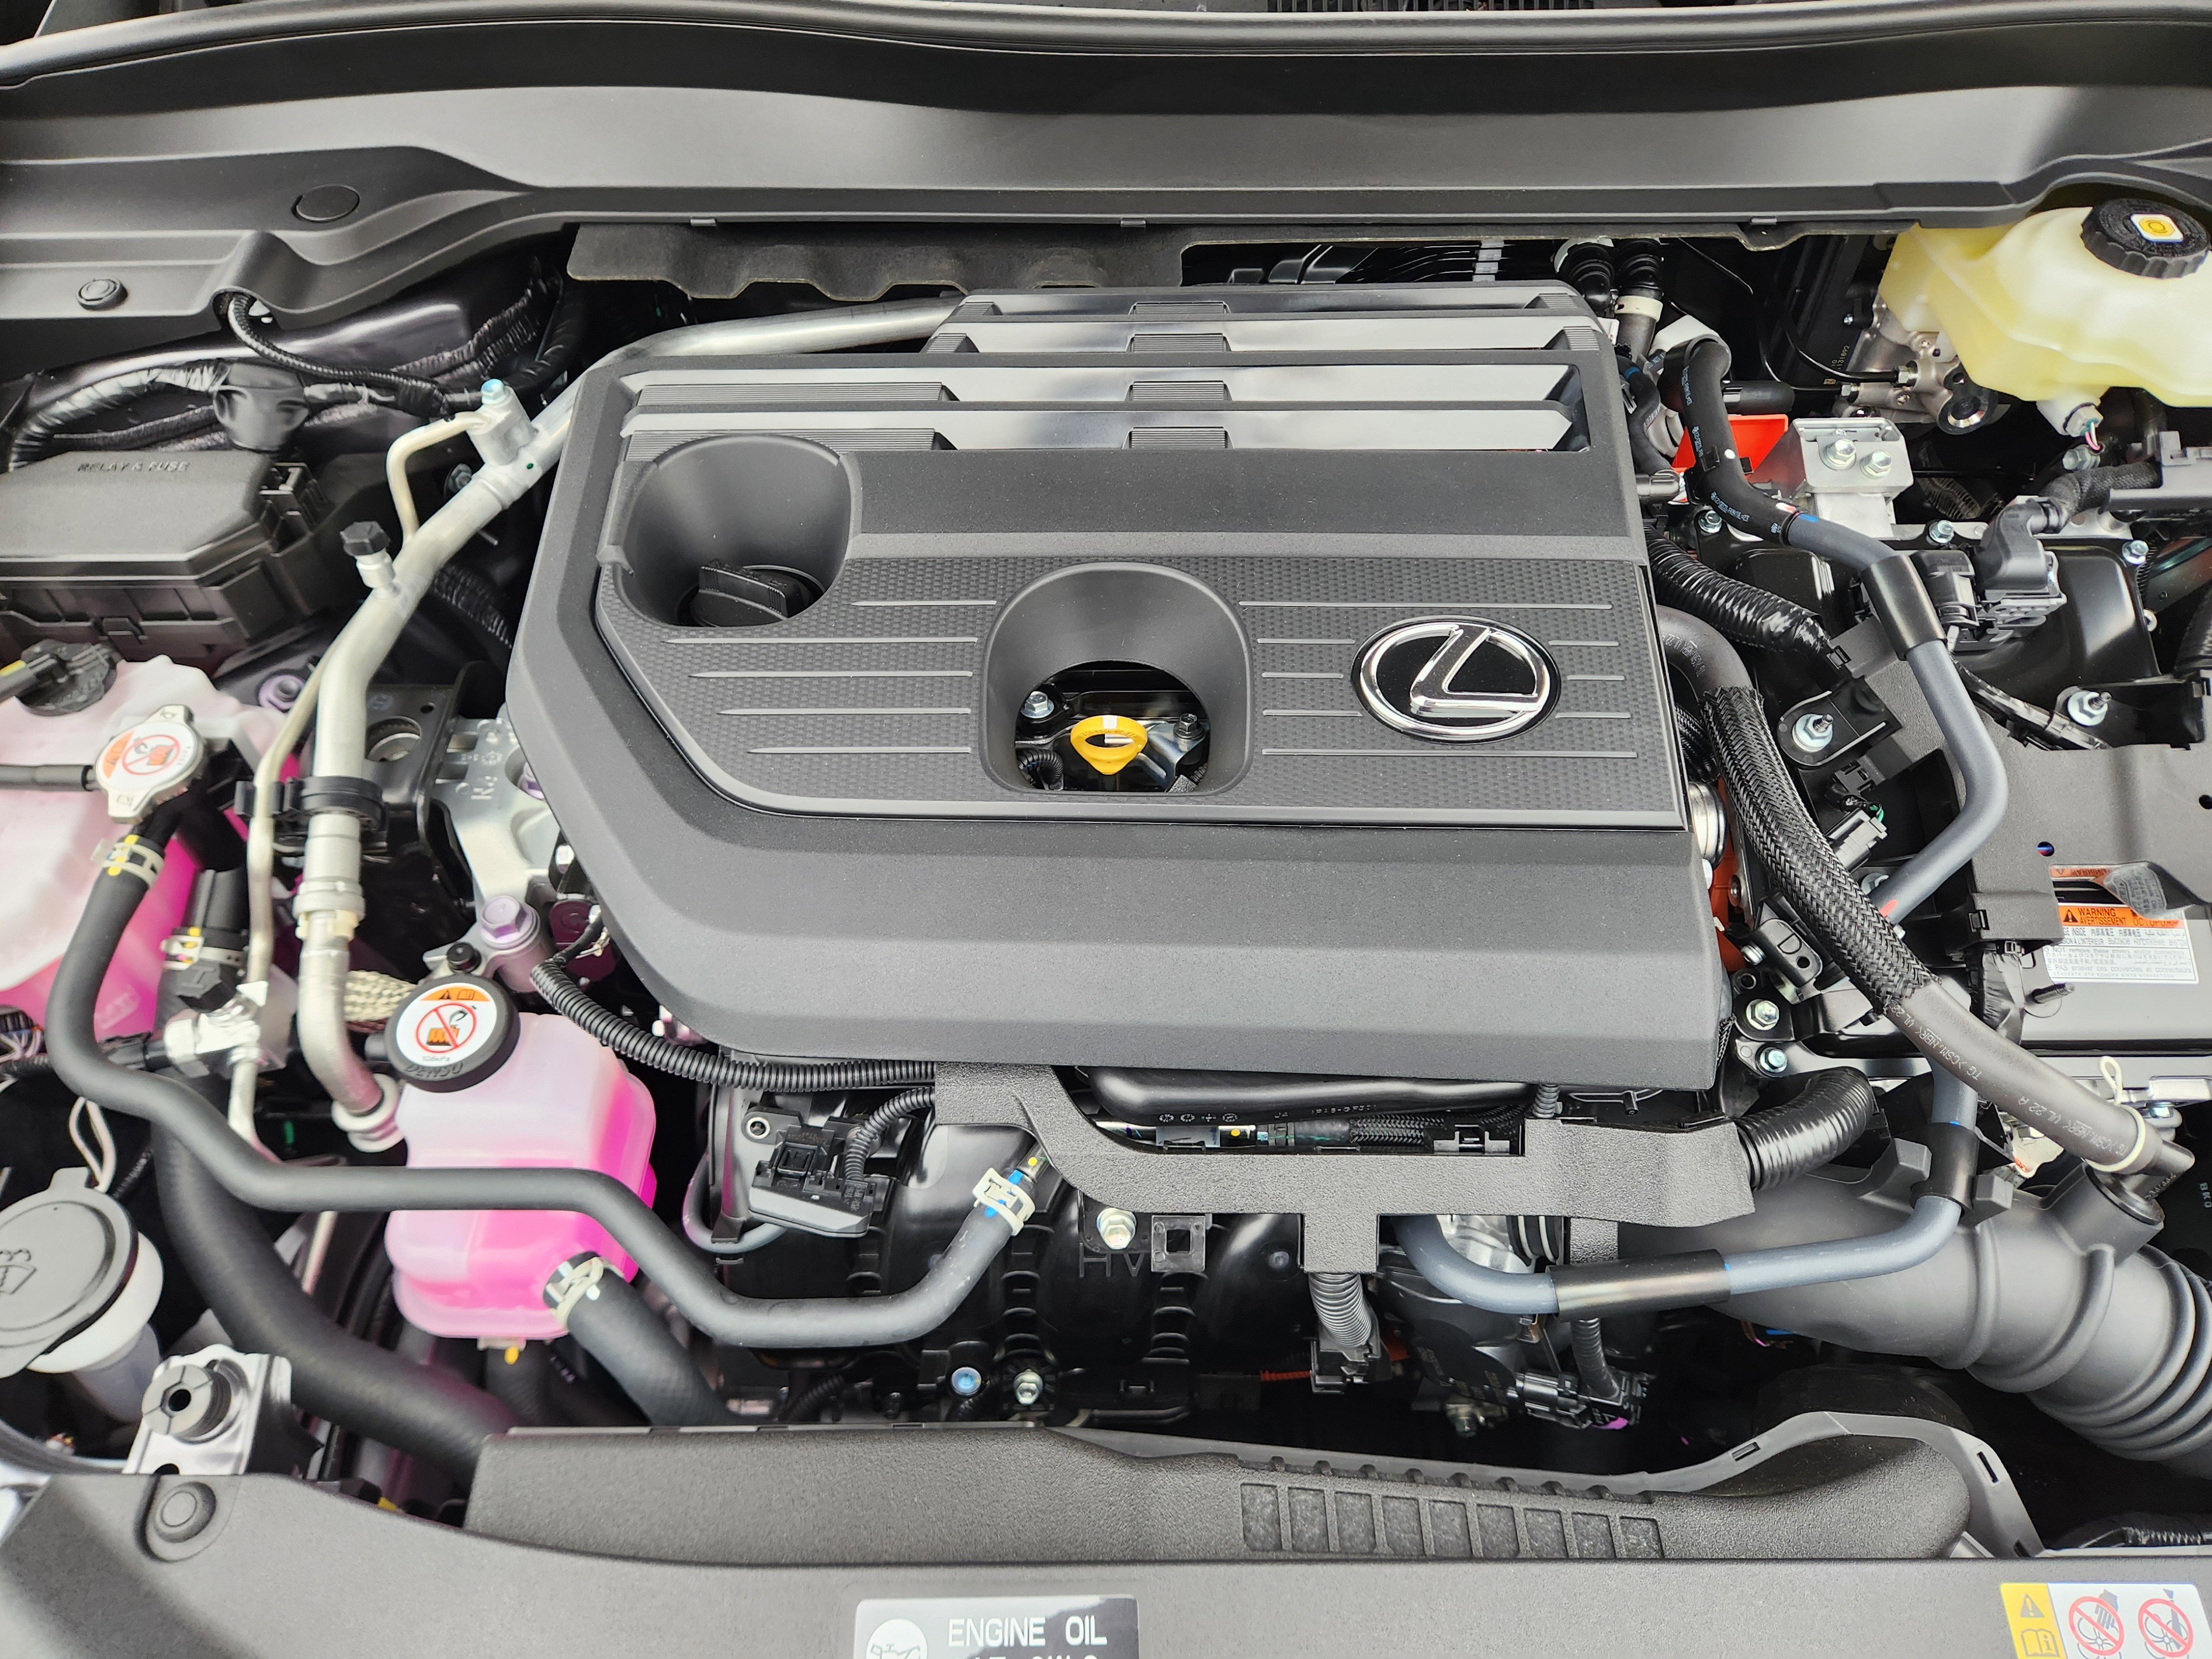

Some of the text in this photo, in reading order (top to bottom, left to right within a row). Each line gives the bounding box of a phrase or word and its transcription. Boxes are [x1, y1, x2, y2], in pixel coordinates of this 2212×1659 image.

[77, 462, 129, 472] RELAY
[148, 461, 190, 472] FUSE
[2078, 907, 2116, 917] WARNING
[2079, 916, 2126, 926] AVERTISSEMENT
[2072, 928, 2086, 936] INSIDE
[404, 1062, 464, 1077] DENSO
[948, 1615, 1108, 1647] ENGINE OIL
